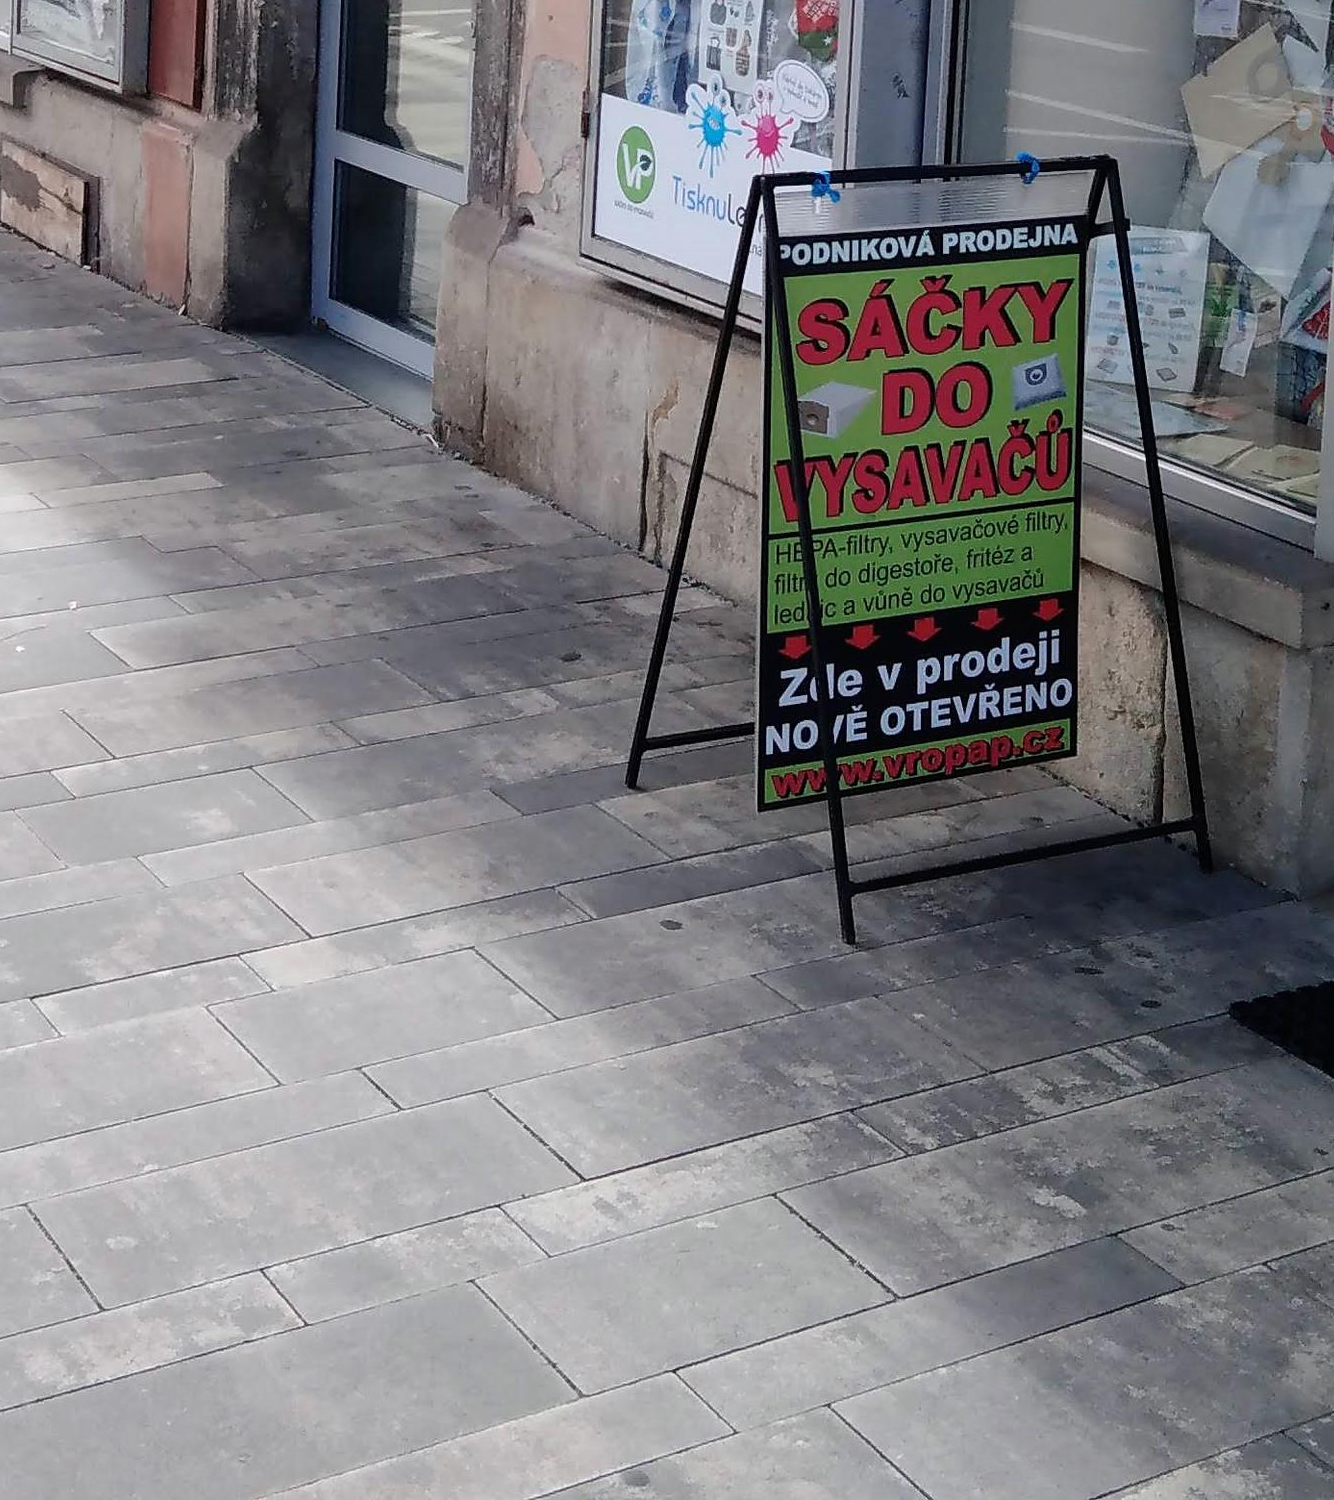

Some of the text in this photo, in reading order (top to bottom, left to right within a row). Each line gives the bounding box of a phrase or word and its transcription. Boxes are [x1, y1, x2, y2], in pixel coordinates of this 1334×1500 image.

[779, 223, 1079, 267] PODNIKOVÁ PRODEJNA
[795, 274, 1075, 366] SÁČKY
[881, 361, 993, 436] DO
[773, 408, 1074, 523] VYSAVAČŮ
[901, 513, 1019, 549] vysavačové
[774, 545, 1034, 595] filtr do digestoře, fritéz a
[774, 568, 1045, 625] ledic a vůně do vysavačů
[878, 662, 902, 691] v
[917, 628, 1061, 696] prodeji
[879, 677, 1074, 736] OTEVŘENO
[772, 726, 1066, 800] www.vropap.cz
